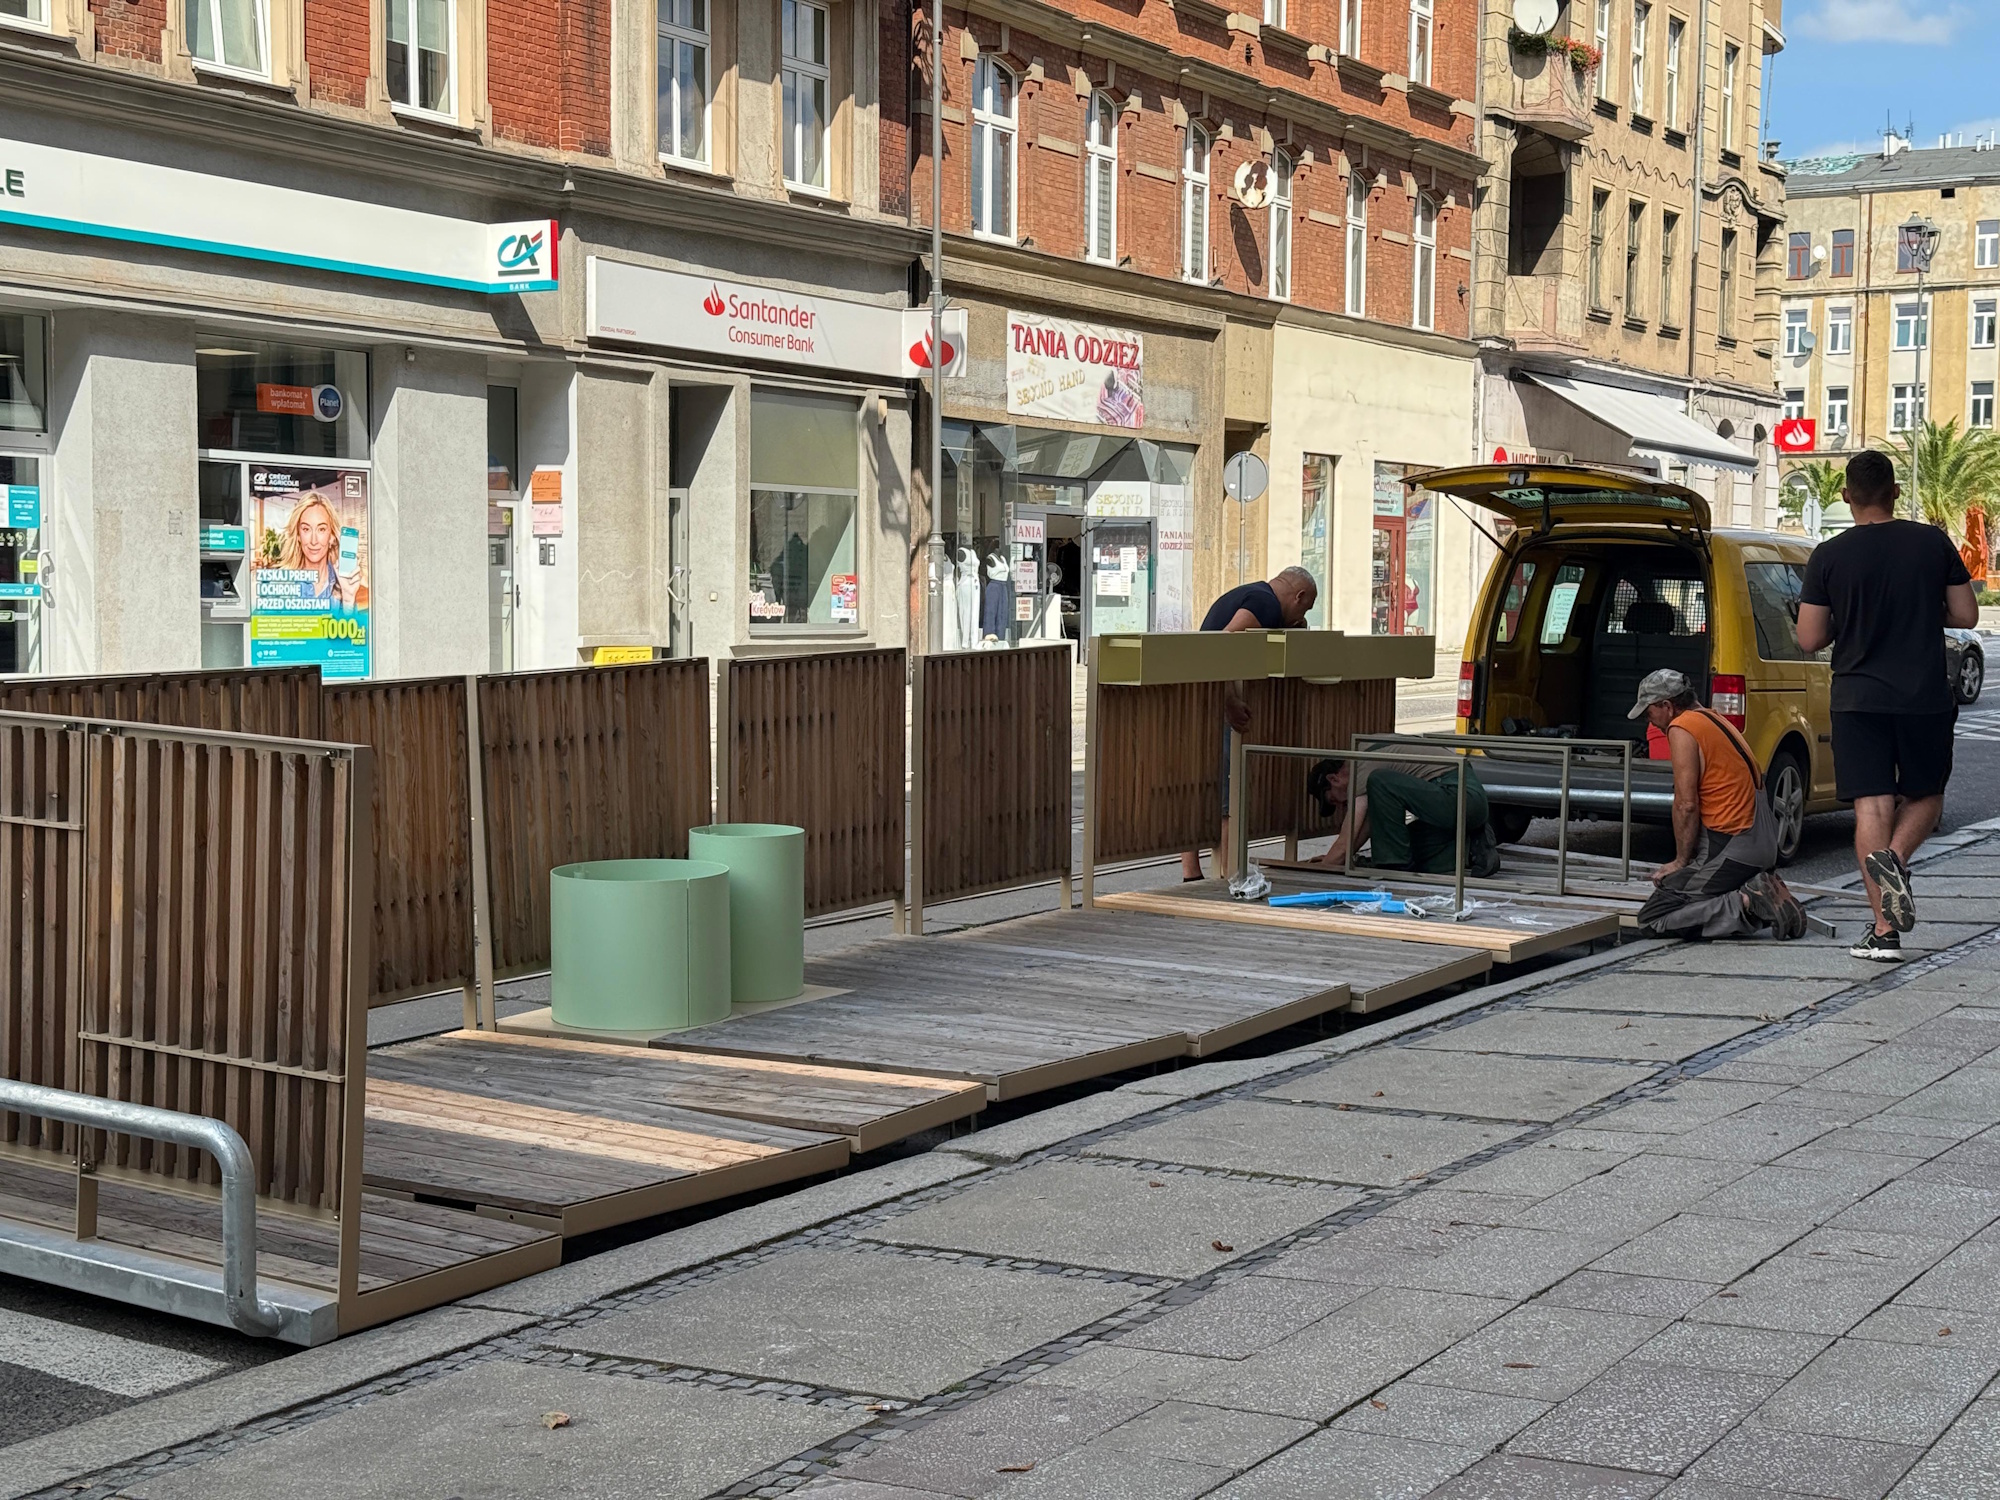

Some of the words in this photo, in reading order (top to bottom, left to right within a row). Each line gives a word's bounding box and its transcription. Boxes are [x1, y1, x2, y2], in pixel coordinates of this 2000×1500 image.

[509, 283, 530, 291] BANK
[728, 294, 816, 329] Santander
[728, 325, 786, 349] Consumer
[787, 335, 815, 353] Bank
[1011, 323, 1069, 360] TANIA
[1074, 336, 1140, 370] ODZIEŻ
[270, 388, 302, 399] bankomat
[1016, 380, 1055, 406] SECOND
[1059, 369, 1086, 392] HAND
[320, 398, 339, 407] Planet
[1096, 494, 1143, 505] SECOND
[1160, 531, 1183, 540] TANIA
[256, 569, 288, 580] ZYSKAJ
[289, 570, 319, 582] PREMIĘ
[261, 584, 301, 597] OCHRONĘ
[257, 598, 283, 609] PRZED
[285, 599, 330, 609] OSZUSTAMI
